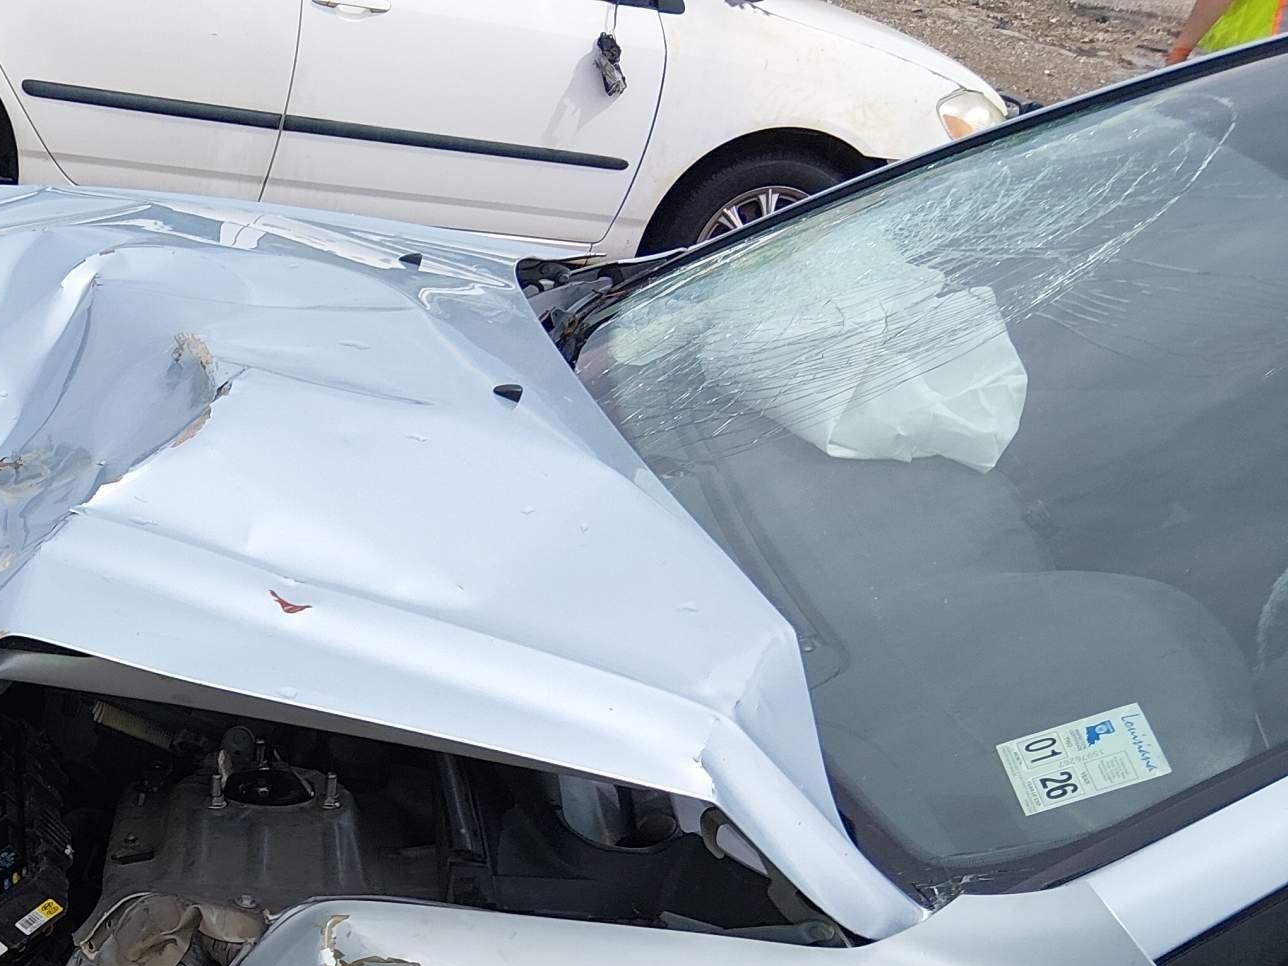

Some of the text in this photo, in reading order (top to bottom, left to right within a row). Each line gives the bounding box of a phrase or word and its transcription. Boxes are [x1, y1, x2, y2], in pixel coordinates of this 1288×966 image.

[1024, 736, 1063, 763] 01
[1121, 713, 1158, 774] Louisiana
[1039, 771, 1079, 800] 26
